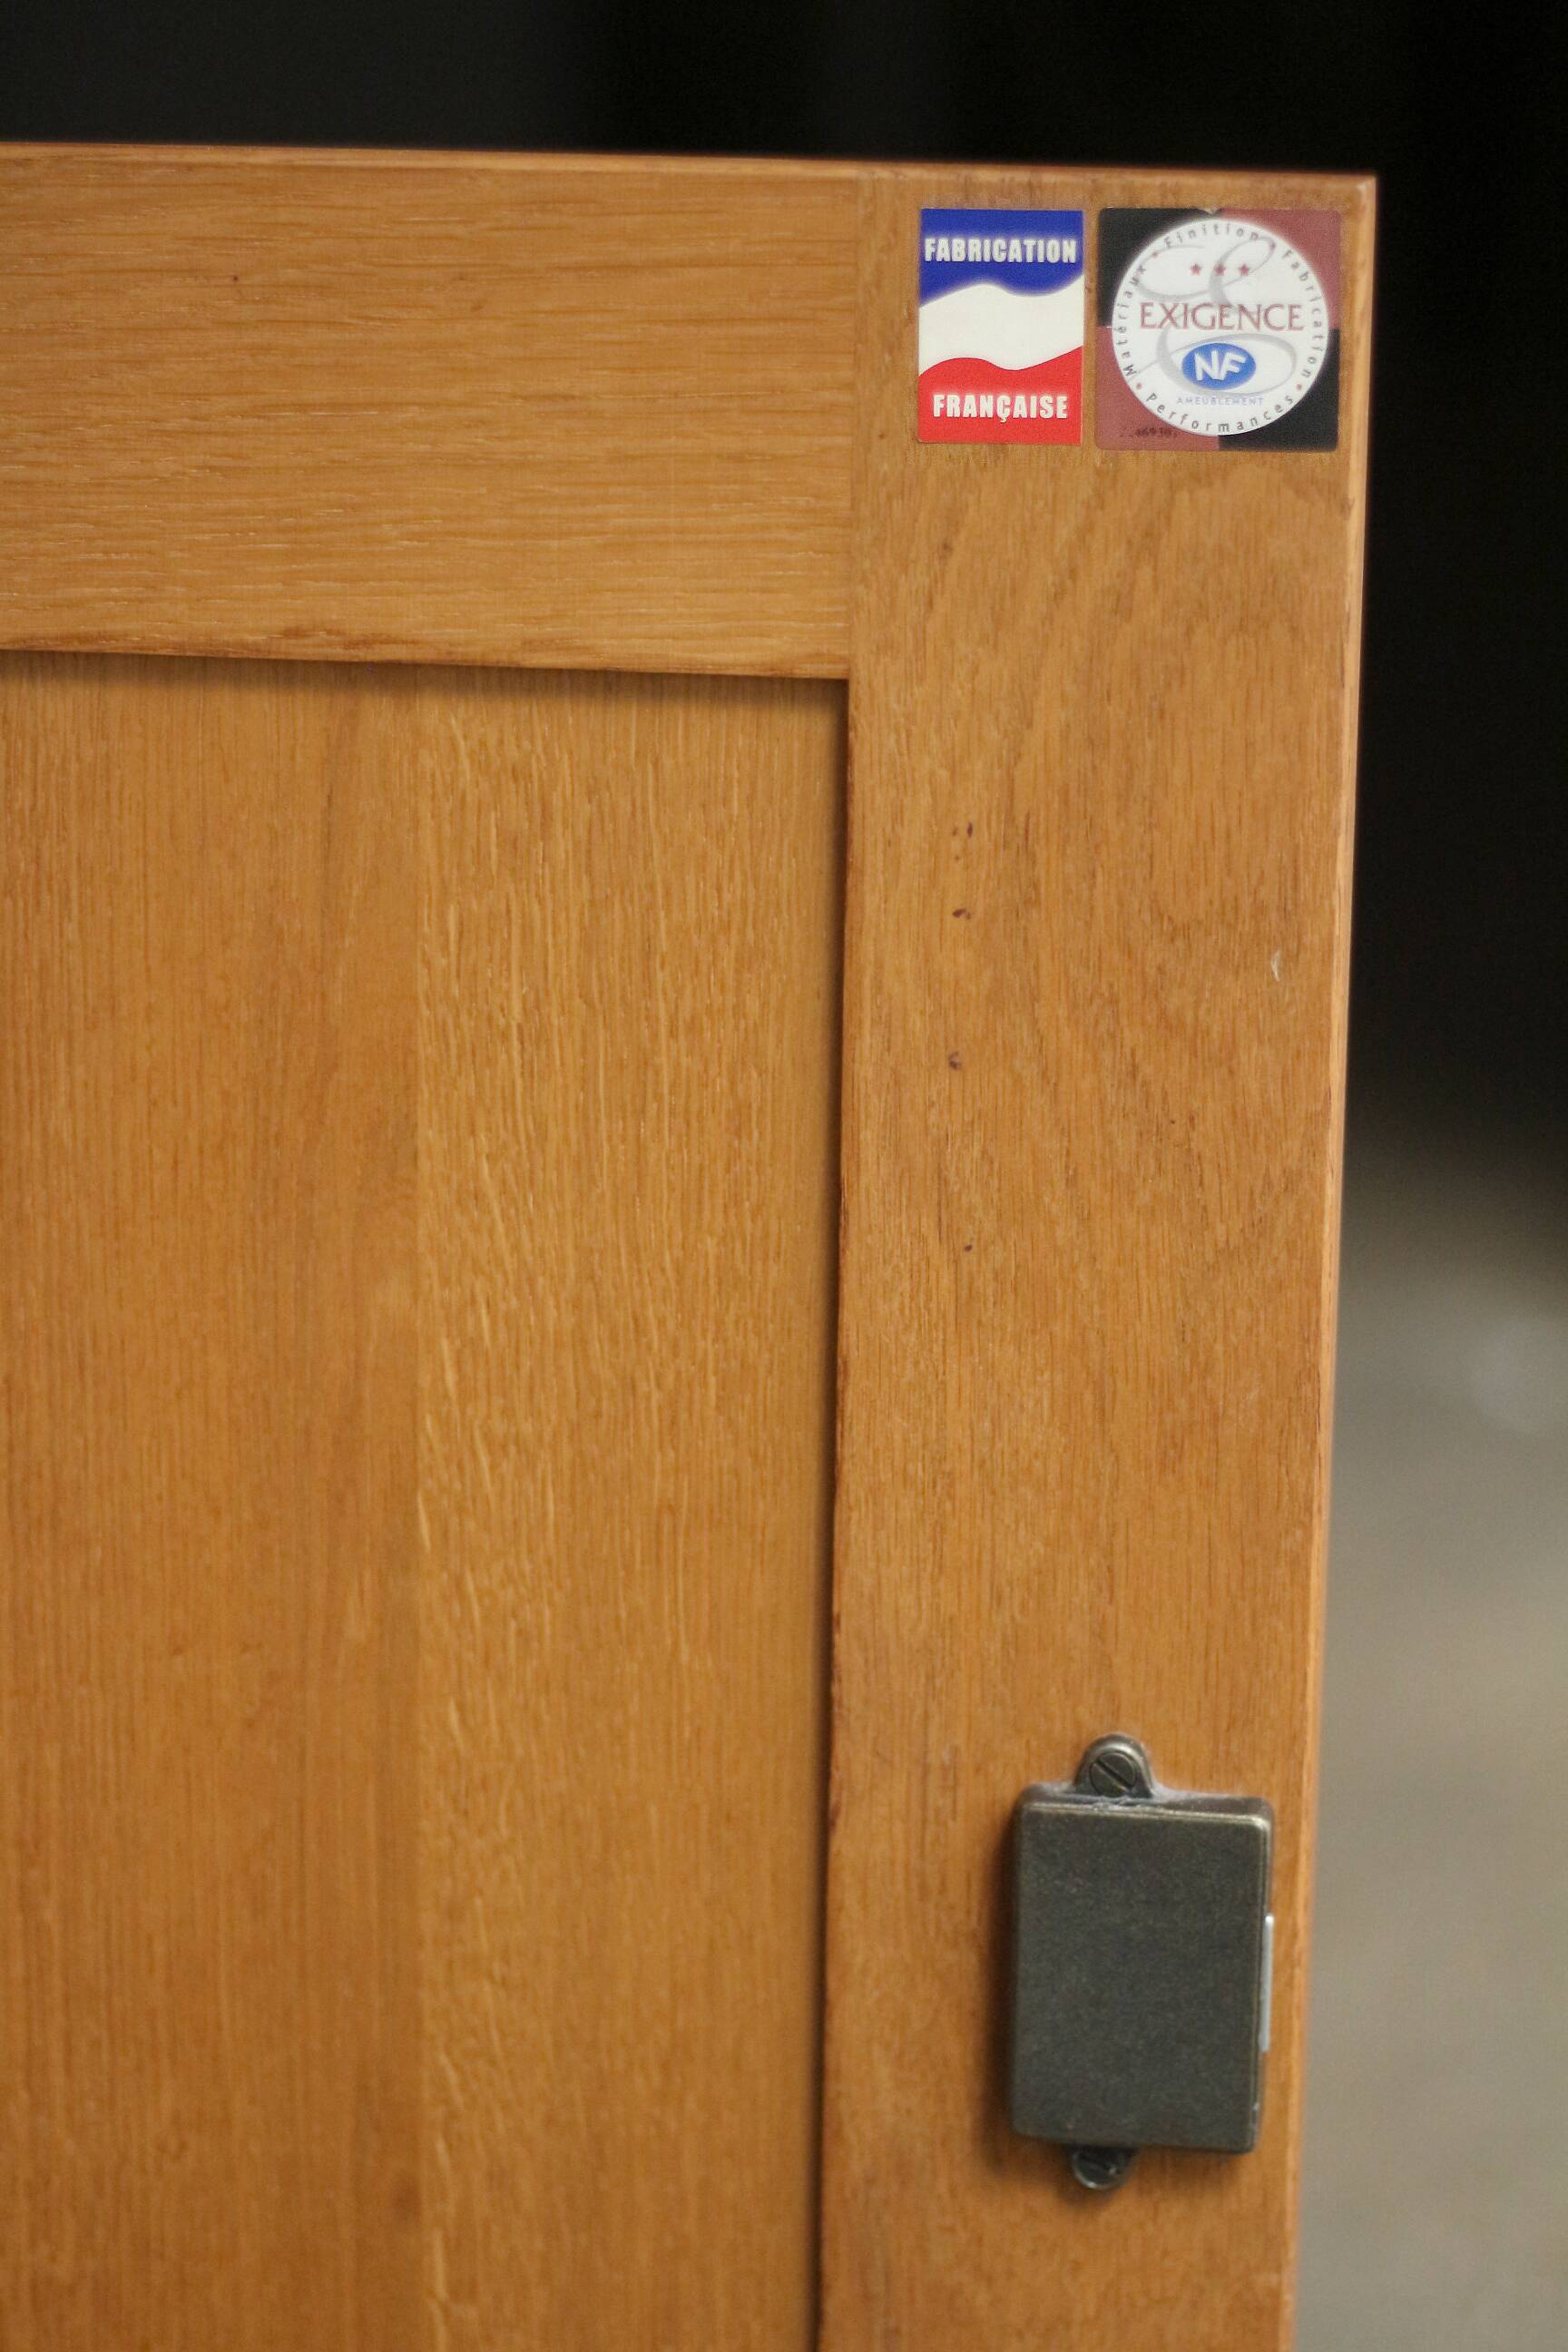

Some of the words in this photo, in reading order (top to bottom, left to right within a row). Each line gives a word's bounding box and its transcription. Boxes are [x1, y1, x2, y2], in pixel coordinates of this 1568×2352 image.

[925, 237, 1077, 263] FABRICATION
[1163, 222, 1259, 249] Finition
[1140, 302, 1307, 331] EXIGENCE
[1281, 249, 1326, 378] Fabrication
[1193, 350, 1246, 381] NF
[932, 393, 1068, 423] FRANÇAISE
[1145, 392, 1294, 433] Performances
[1176, 397, 1264, 407] AMEUBLEMENT
